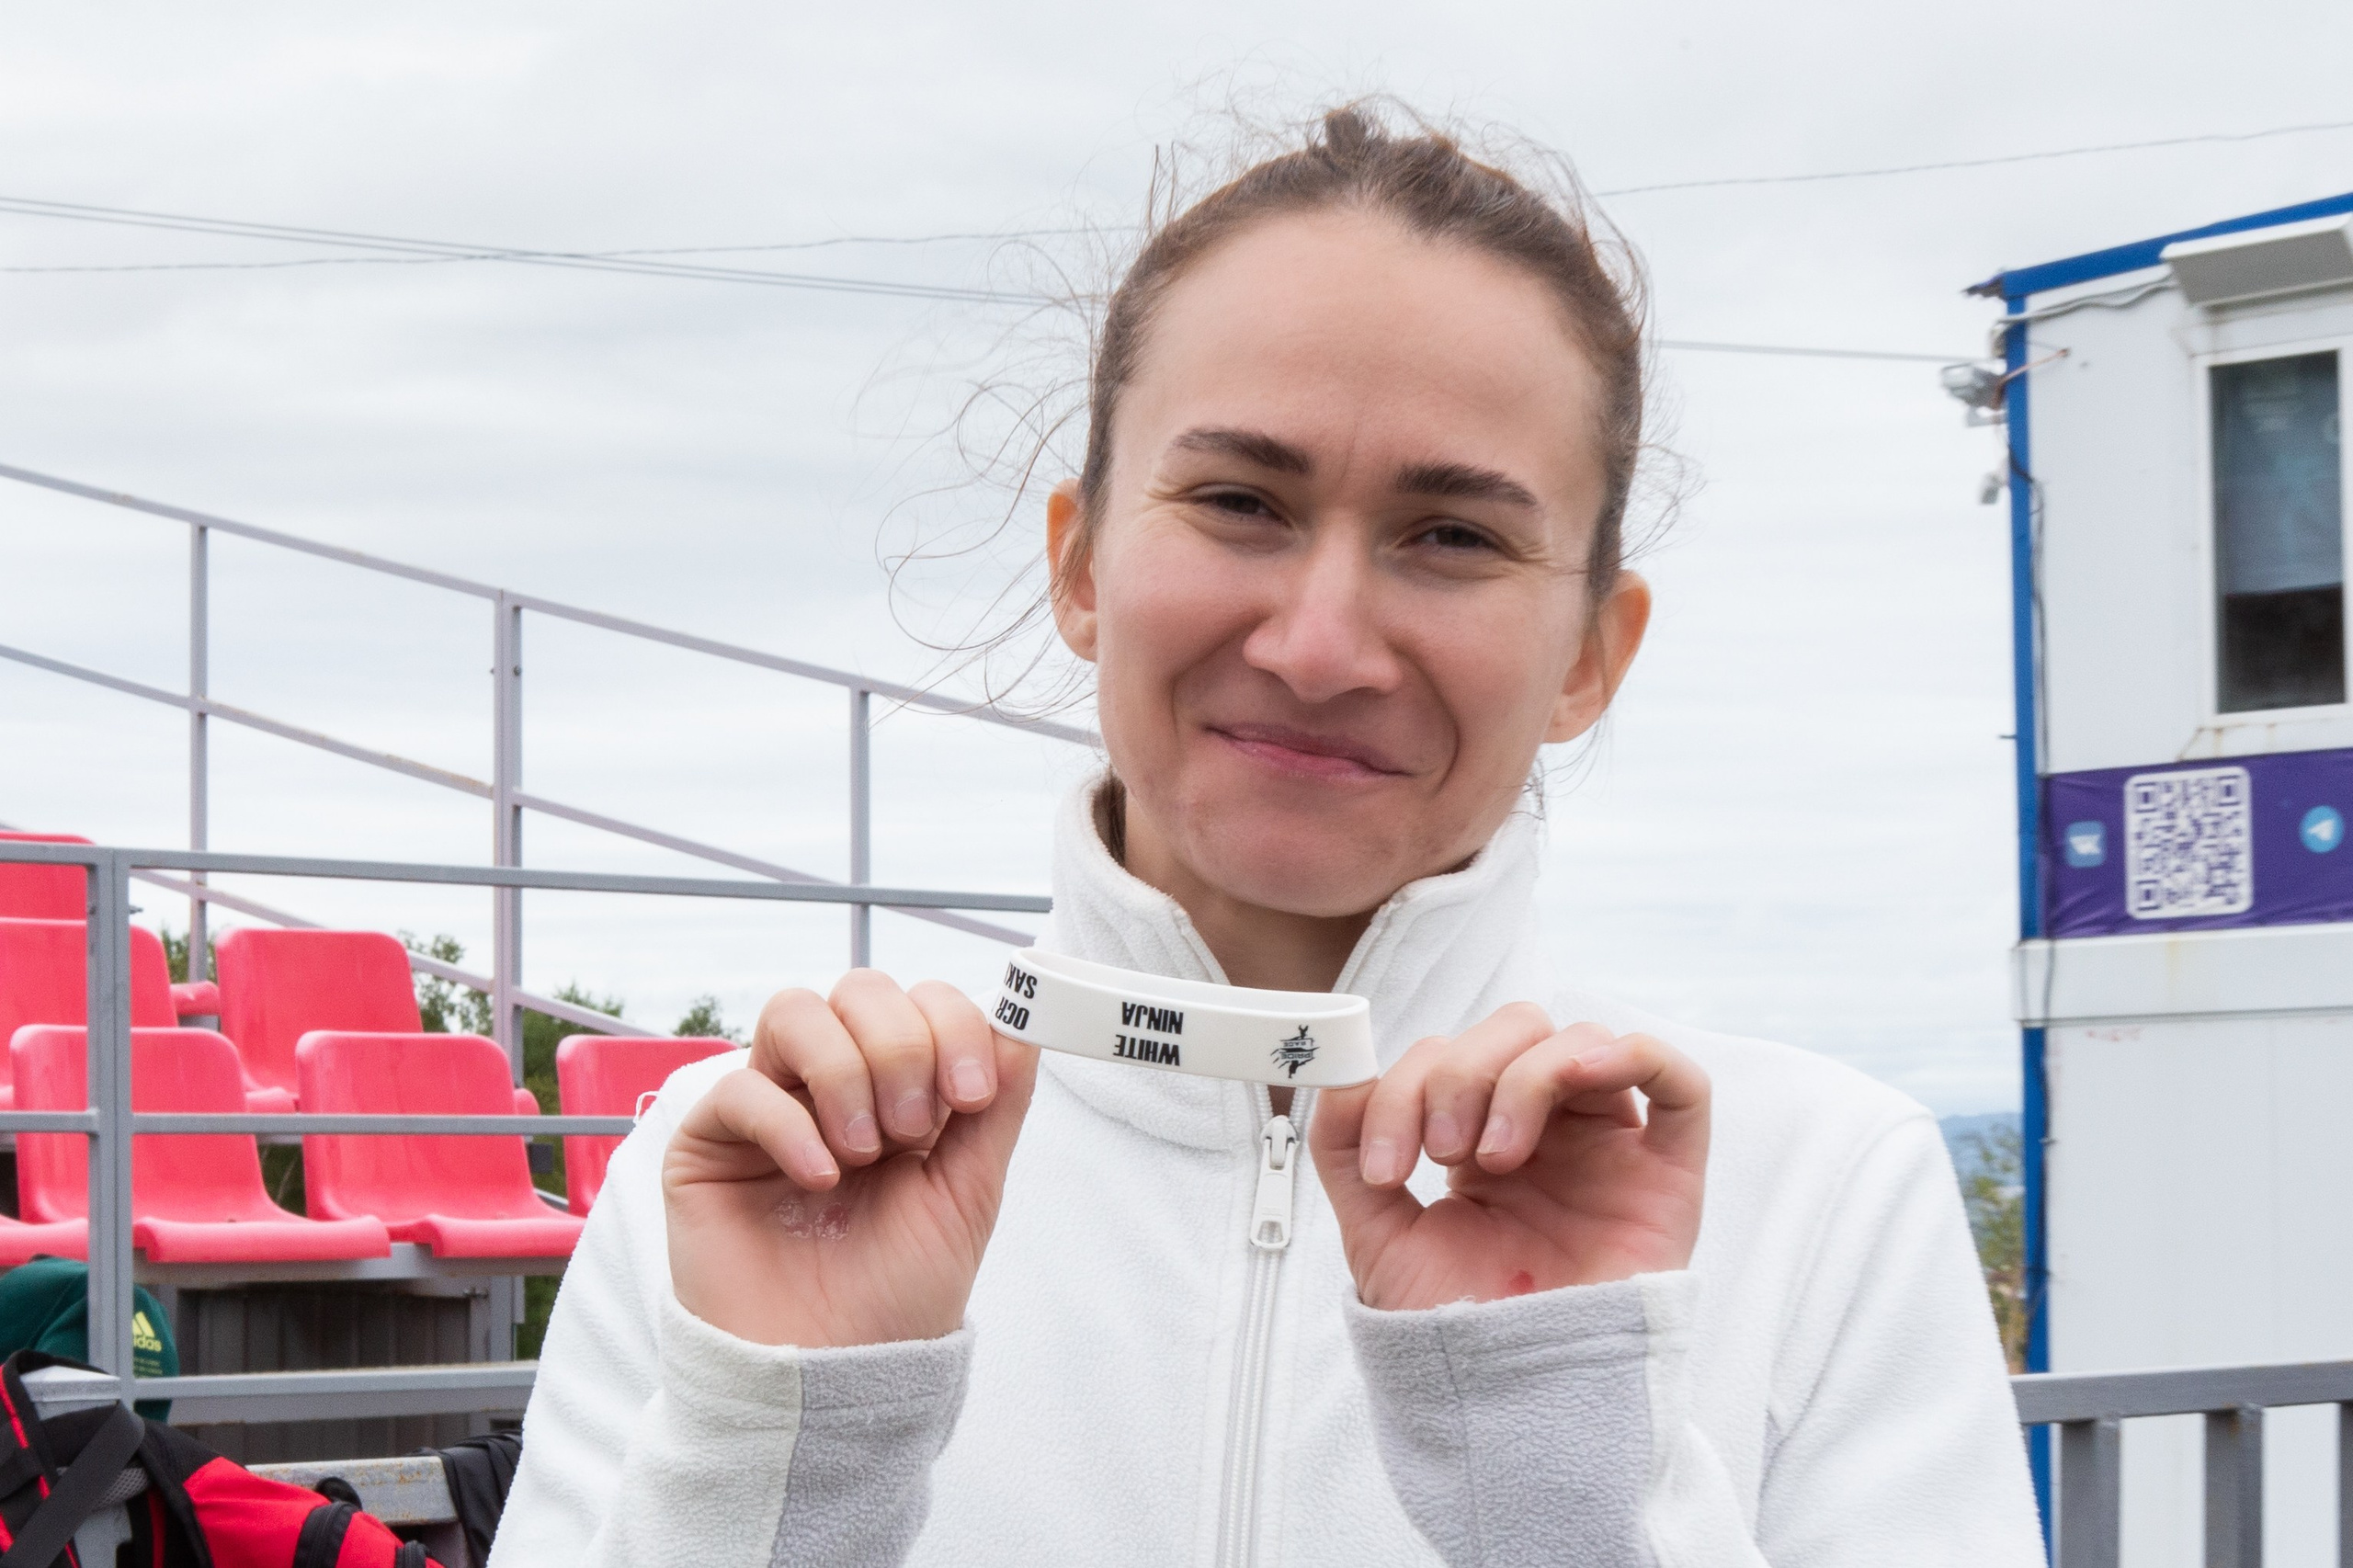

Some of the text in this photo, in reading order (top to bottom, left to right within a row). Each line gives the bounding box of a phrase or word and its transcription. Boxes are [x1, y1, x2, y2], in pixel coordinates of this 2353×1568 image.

[1004, 961, 1038, 999] SAK
[995, 996, 1029, 1030] OCR
[1121, 1002, 1184, 1035] NINJA
[1113, 1034, 1180, 1066] WHITE
[1280, 1051, 1311, 1060] PRIDE
[133, 1335, 162, 1352] idas
